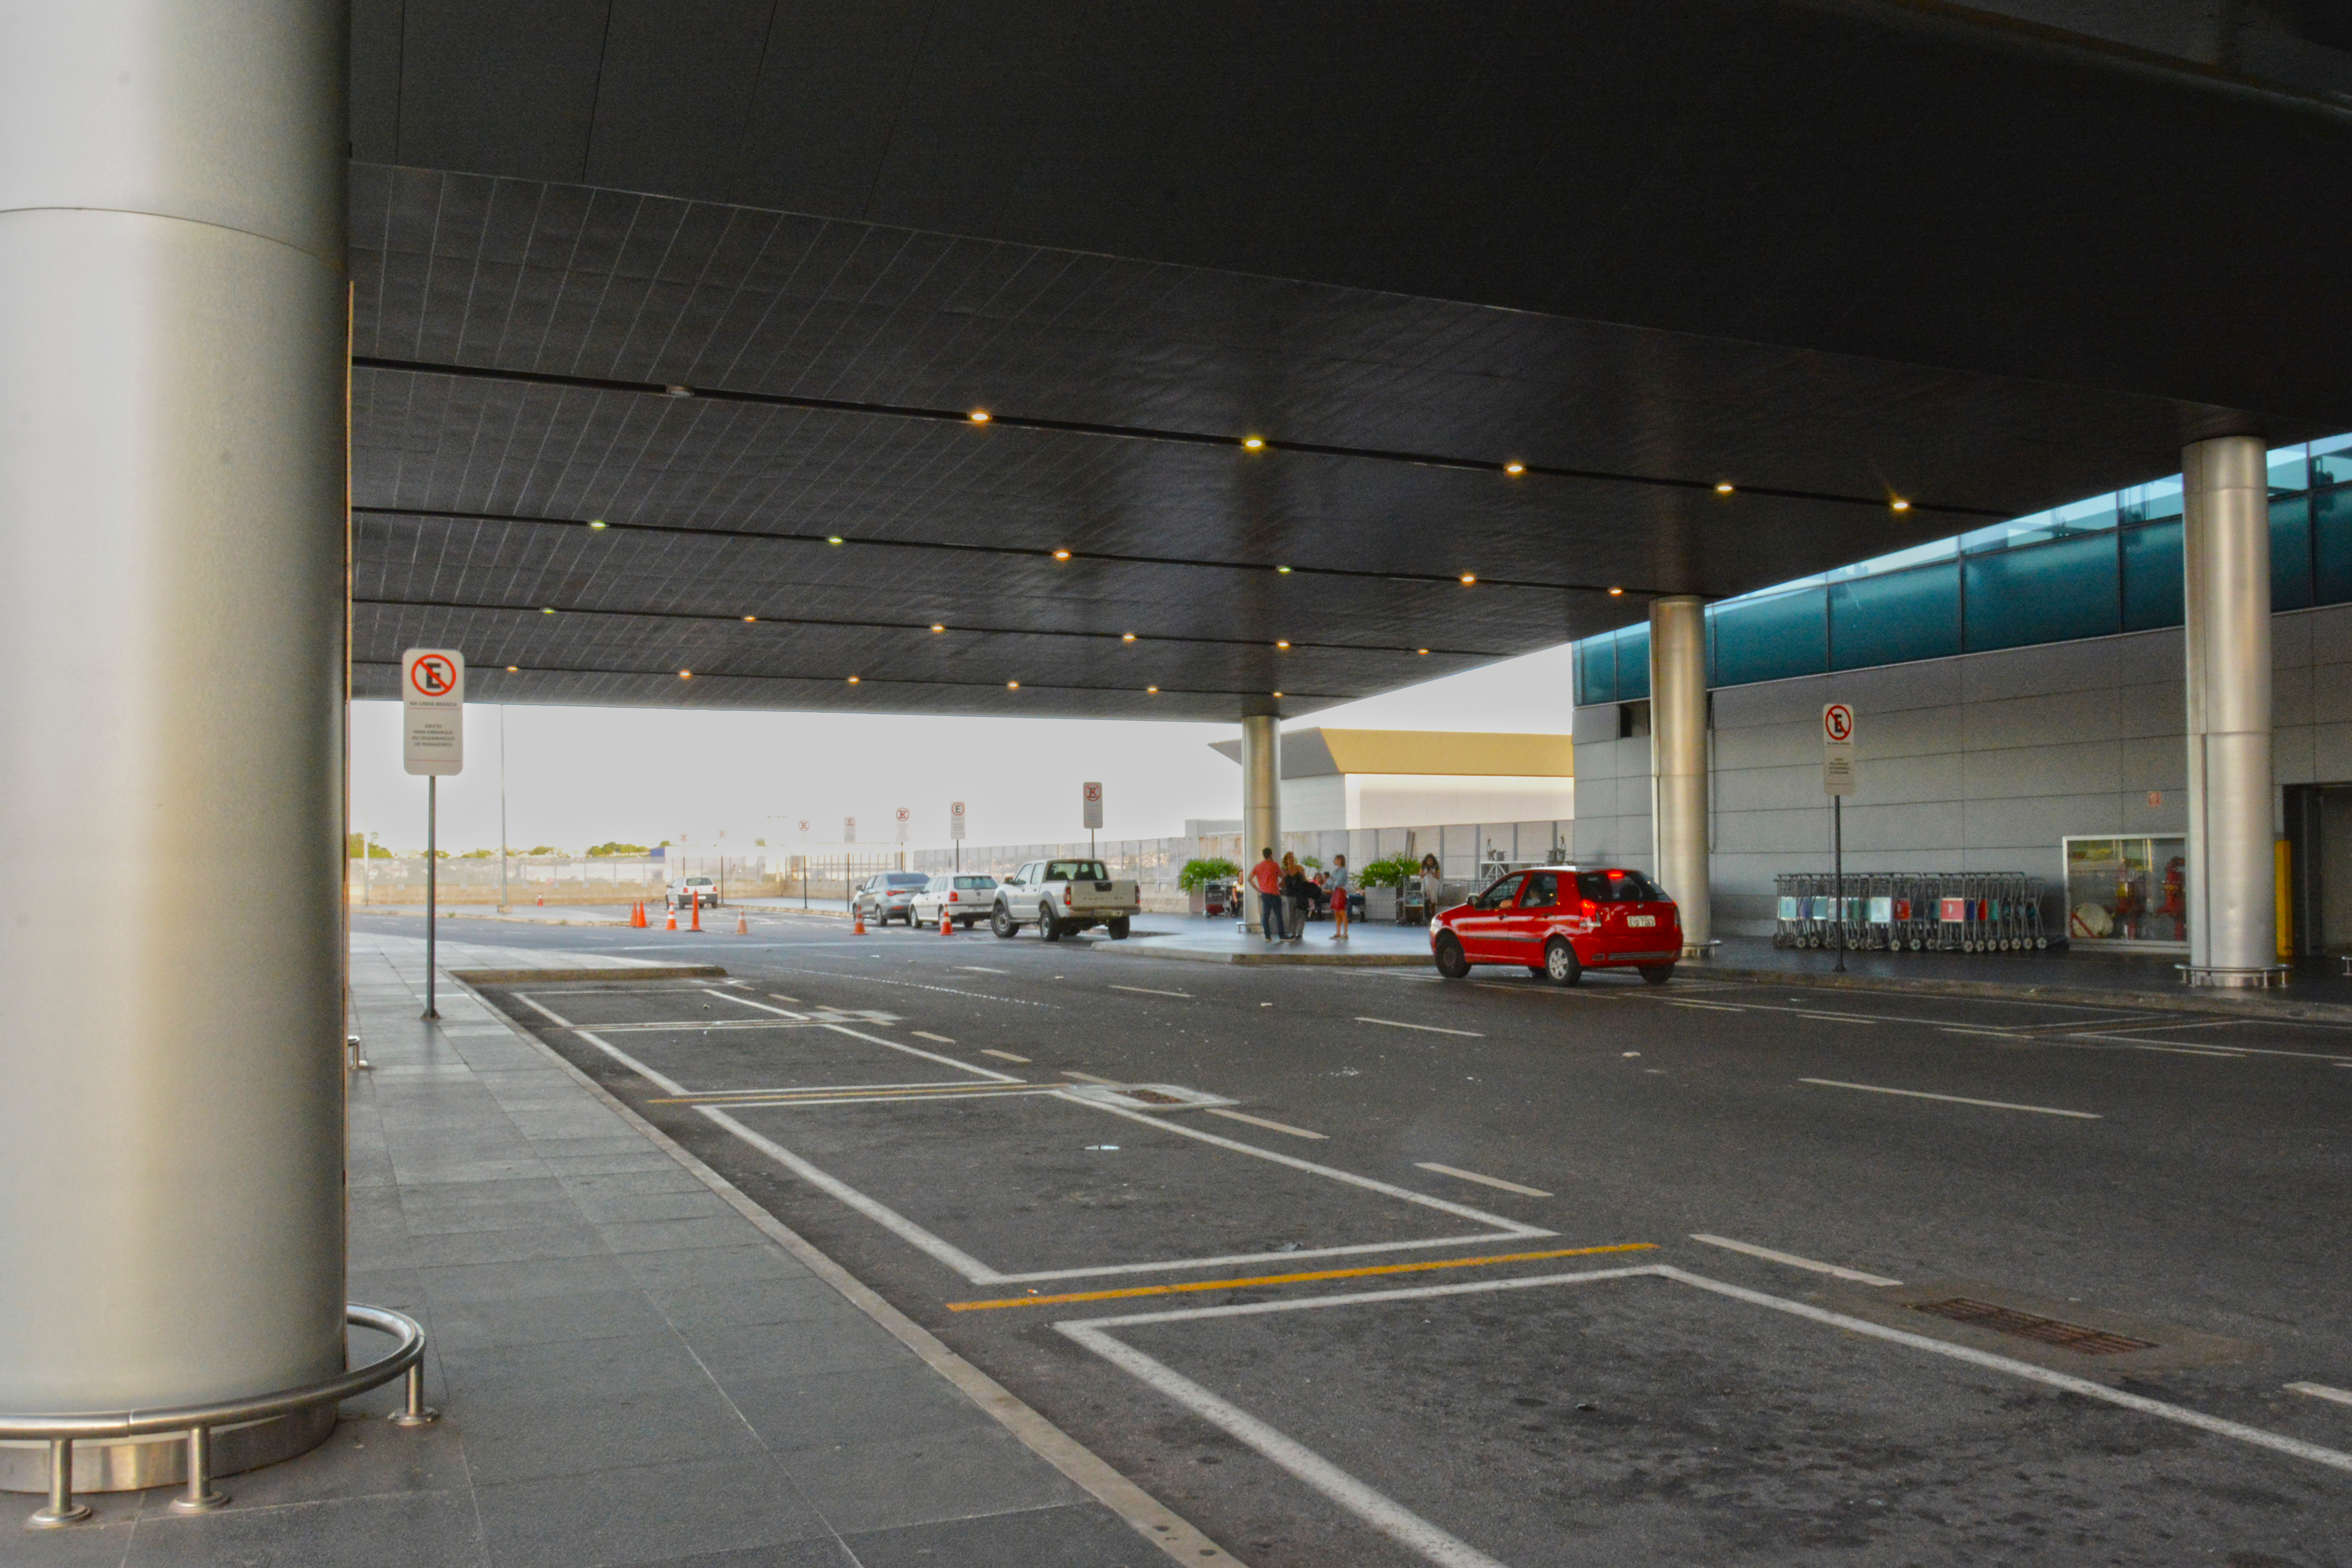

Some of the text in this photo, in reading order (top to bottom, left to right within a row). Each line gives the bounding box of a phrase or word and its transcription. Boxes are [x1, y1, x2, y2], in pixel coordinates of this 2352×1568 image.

[426, 662, 442, 689] E
[1835, 713, 1843, 733] E
[955, 805, 961, 813] E
